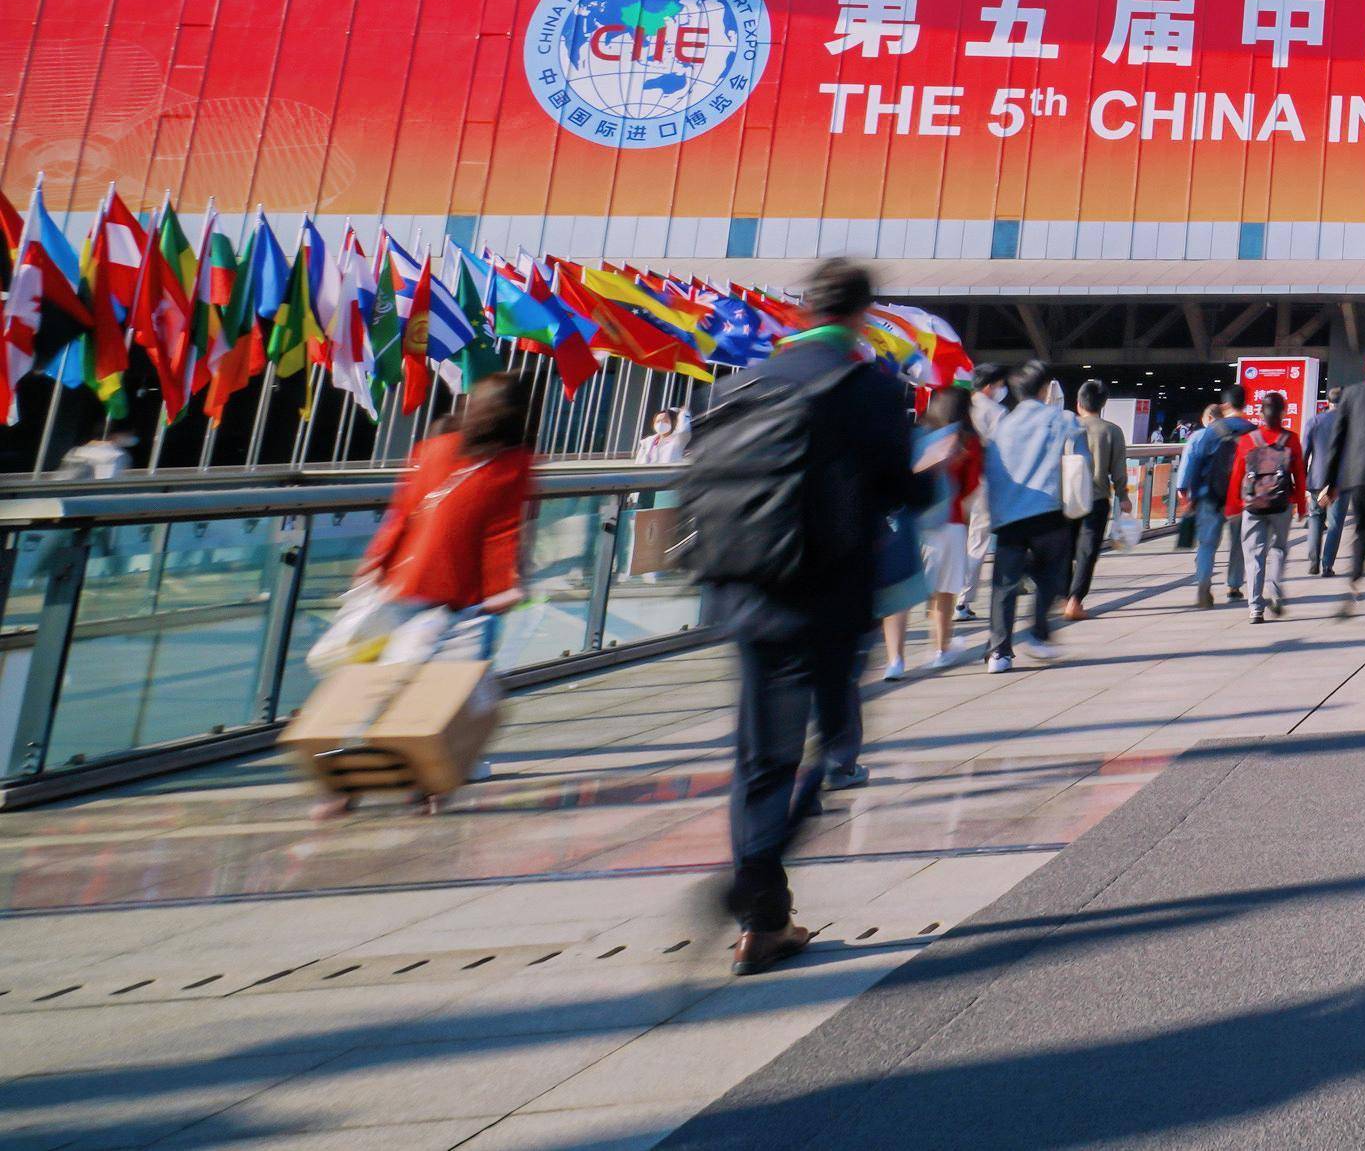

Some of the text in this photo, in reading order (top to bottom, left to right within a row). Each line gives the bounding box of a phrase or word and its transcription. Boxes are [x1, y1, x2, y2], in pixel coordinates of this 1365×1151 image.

[538, 5, 565, 54] CHINA
[743, 20, 758, 61] EXPO
[590, 24, 709, 64] CIIE
[539, 74, 748, 141] 中国国际进口博览会
[819, 83, 964, 136] THE
[987, 86, 1067, 138] 5th
[1090, 89, 1306, 142] CHINA
